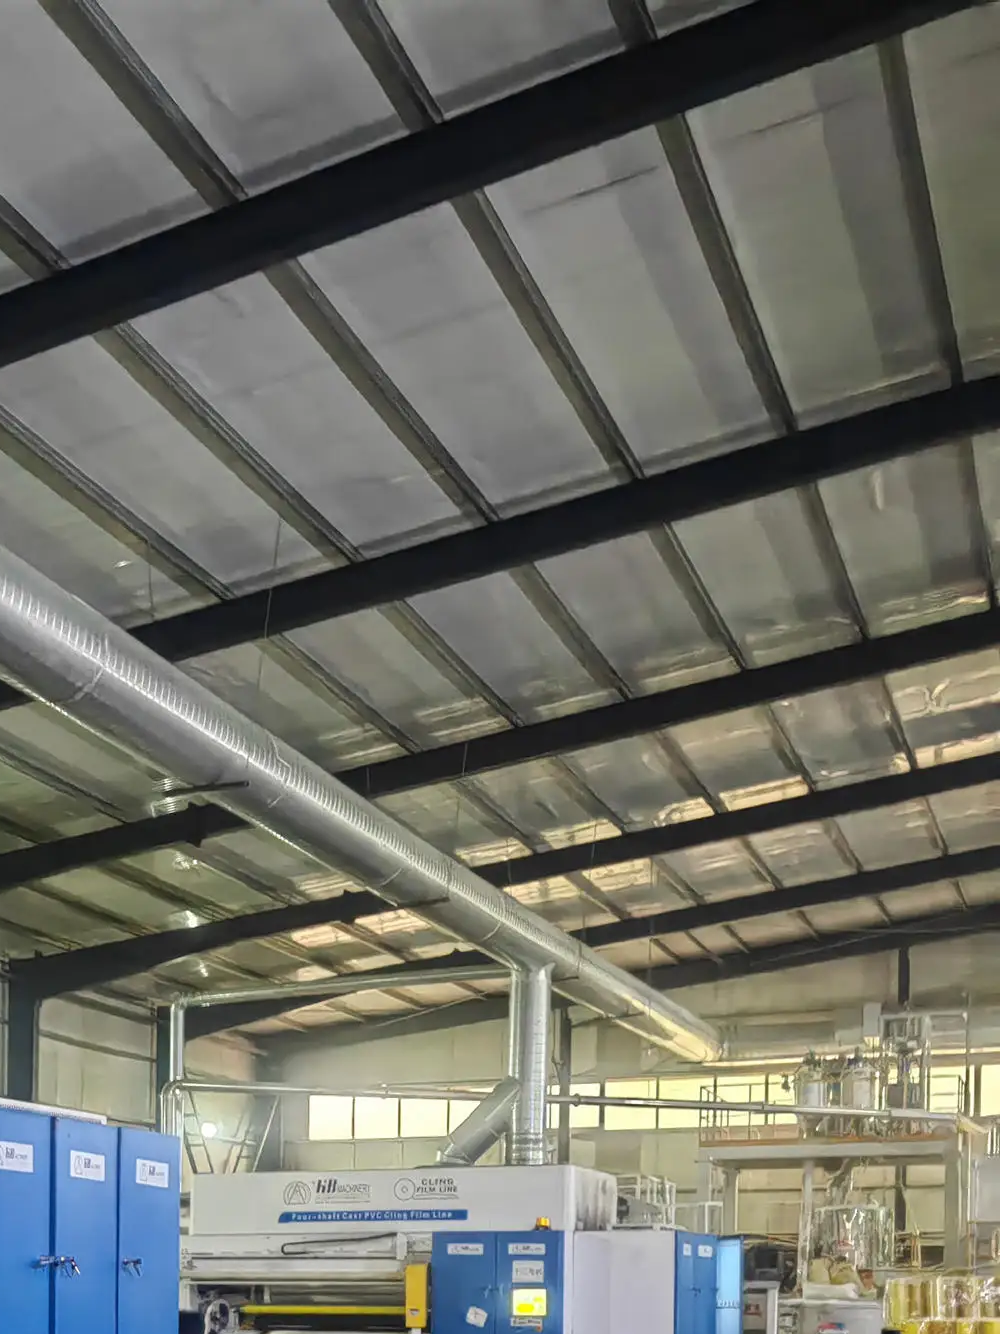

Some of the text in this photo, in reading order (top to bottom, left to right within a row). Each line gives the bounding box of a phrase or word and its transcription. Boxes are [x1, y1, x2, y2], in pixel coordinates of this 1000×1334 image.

[364, 1211, 382, 1220] PVC
[383, 1211, 408, 1221] Cling
[410, 1210, 431, 1219] Film
[432, 1210, 453, 1219] Line
